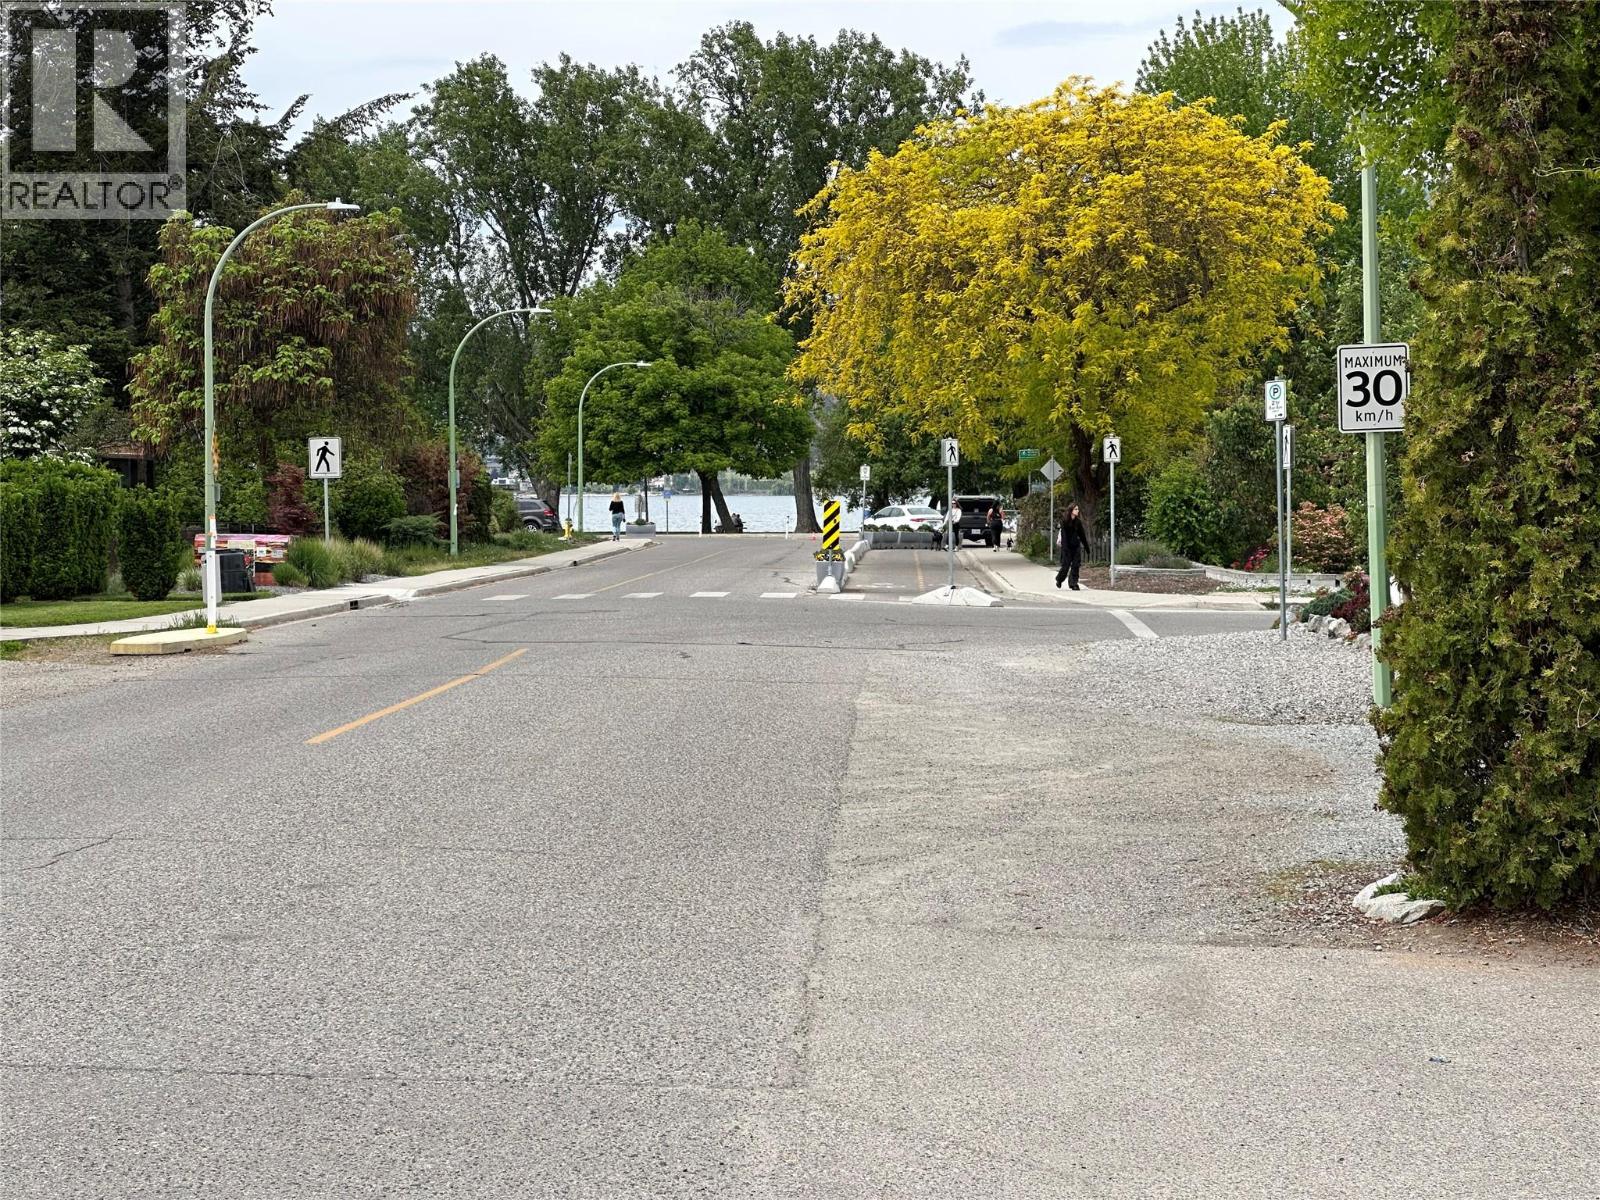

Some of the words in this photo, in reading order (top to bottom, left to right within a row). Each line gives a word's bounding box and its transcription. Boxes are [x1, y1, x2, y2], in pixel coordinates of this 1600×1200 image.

[1345, 355, 1402, 368] MAXIMUM
[1272, 387, 1279, 397] P
[1345, 370, 1402, 407] 30
[1356, 409, 1393, 423] km/h
